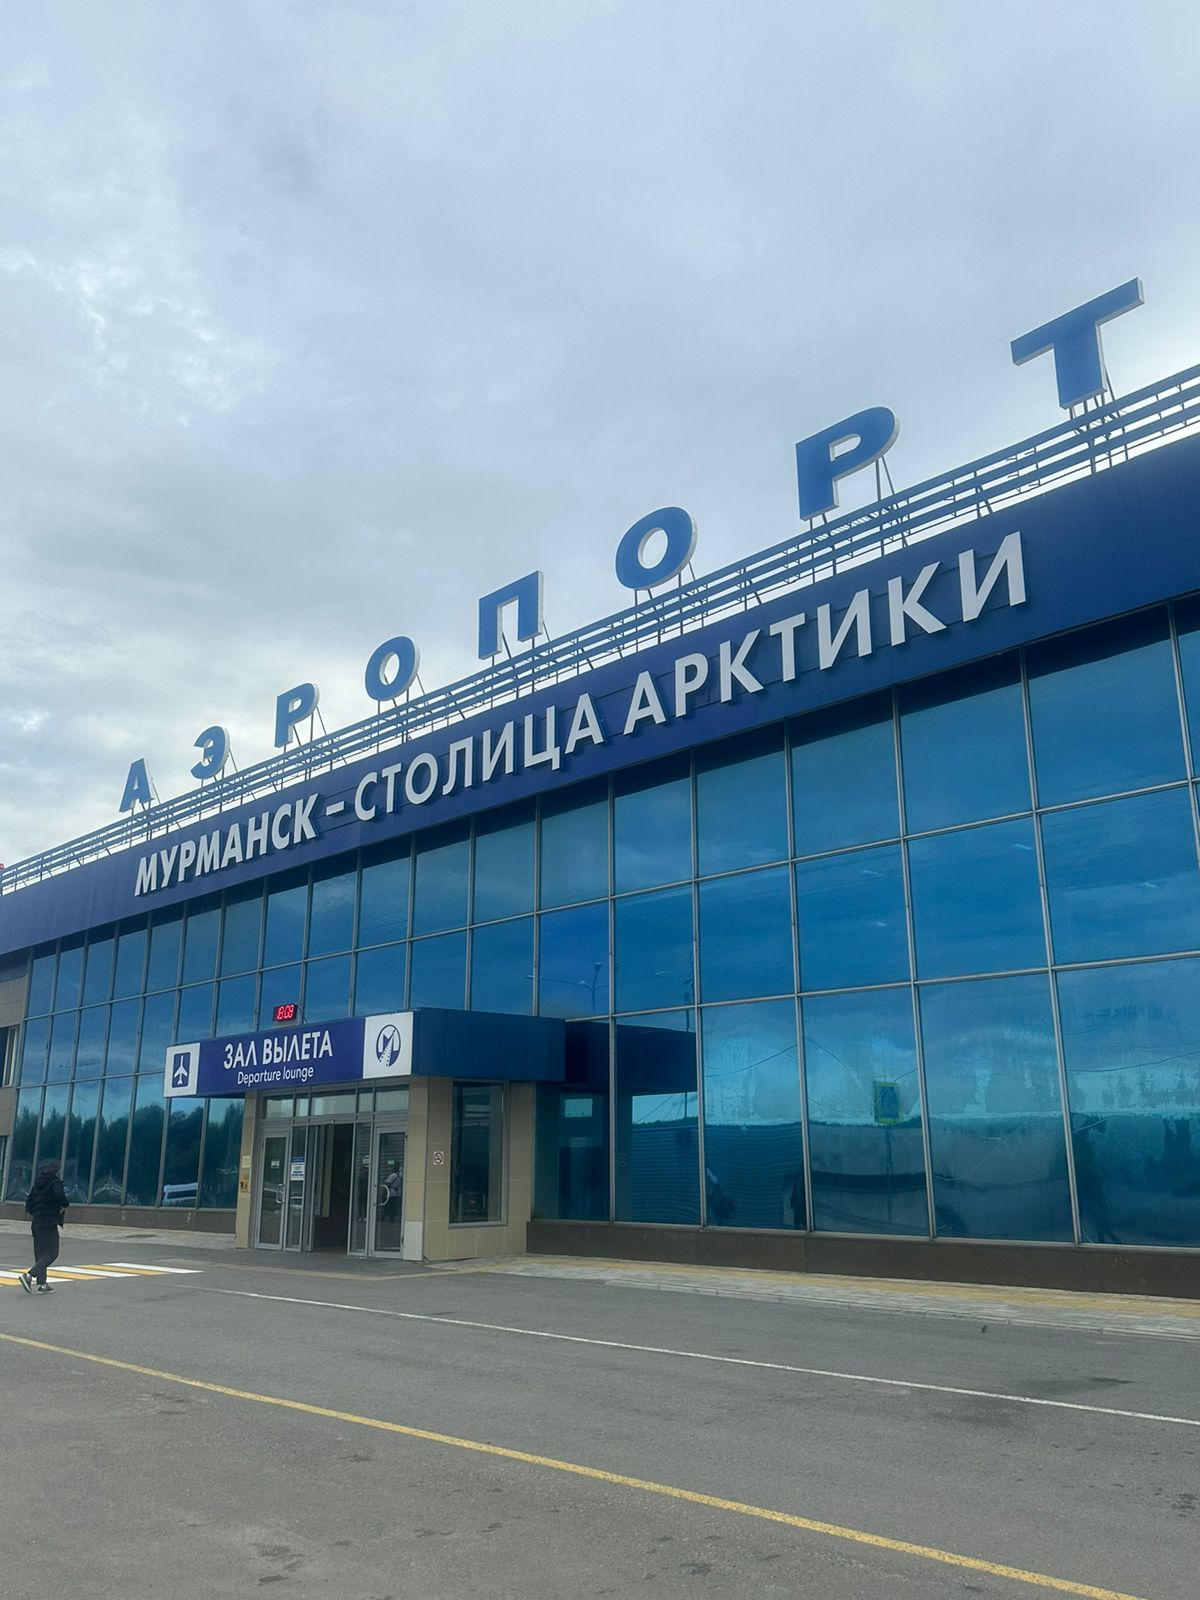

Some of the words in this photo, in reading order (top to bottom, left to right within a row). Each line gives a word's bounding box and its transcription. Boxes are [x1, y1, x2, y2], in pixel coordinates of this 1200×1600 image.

[119, 277, 1145, 813] АЭРОПОРТ
[623, 531, 1028, 735] АРКТИКИ
[223, 1040, 258, 1070] ЗАЛ
[262, 1030, 333, 1065] ВЫЛЕТА
[237, 1069, 281, 1087] Departure
[282, 1066, 314, 1082] lounge
